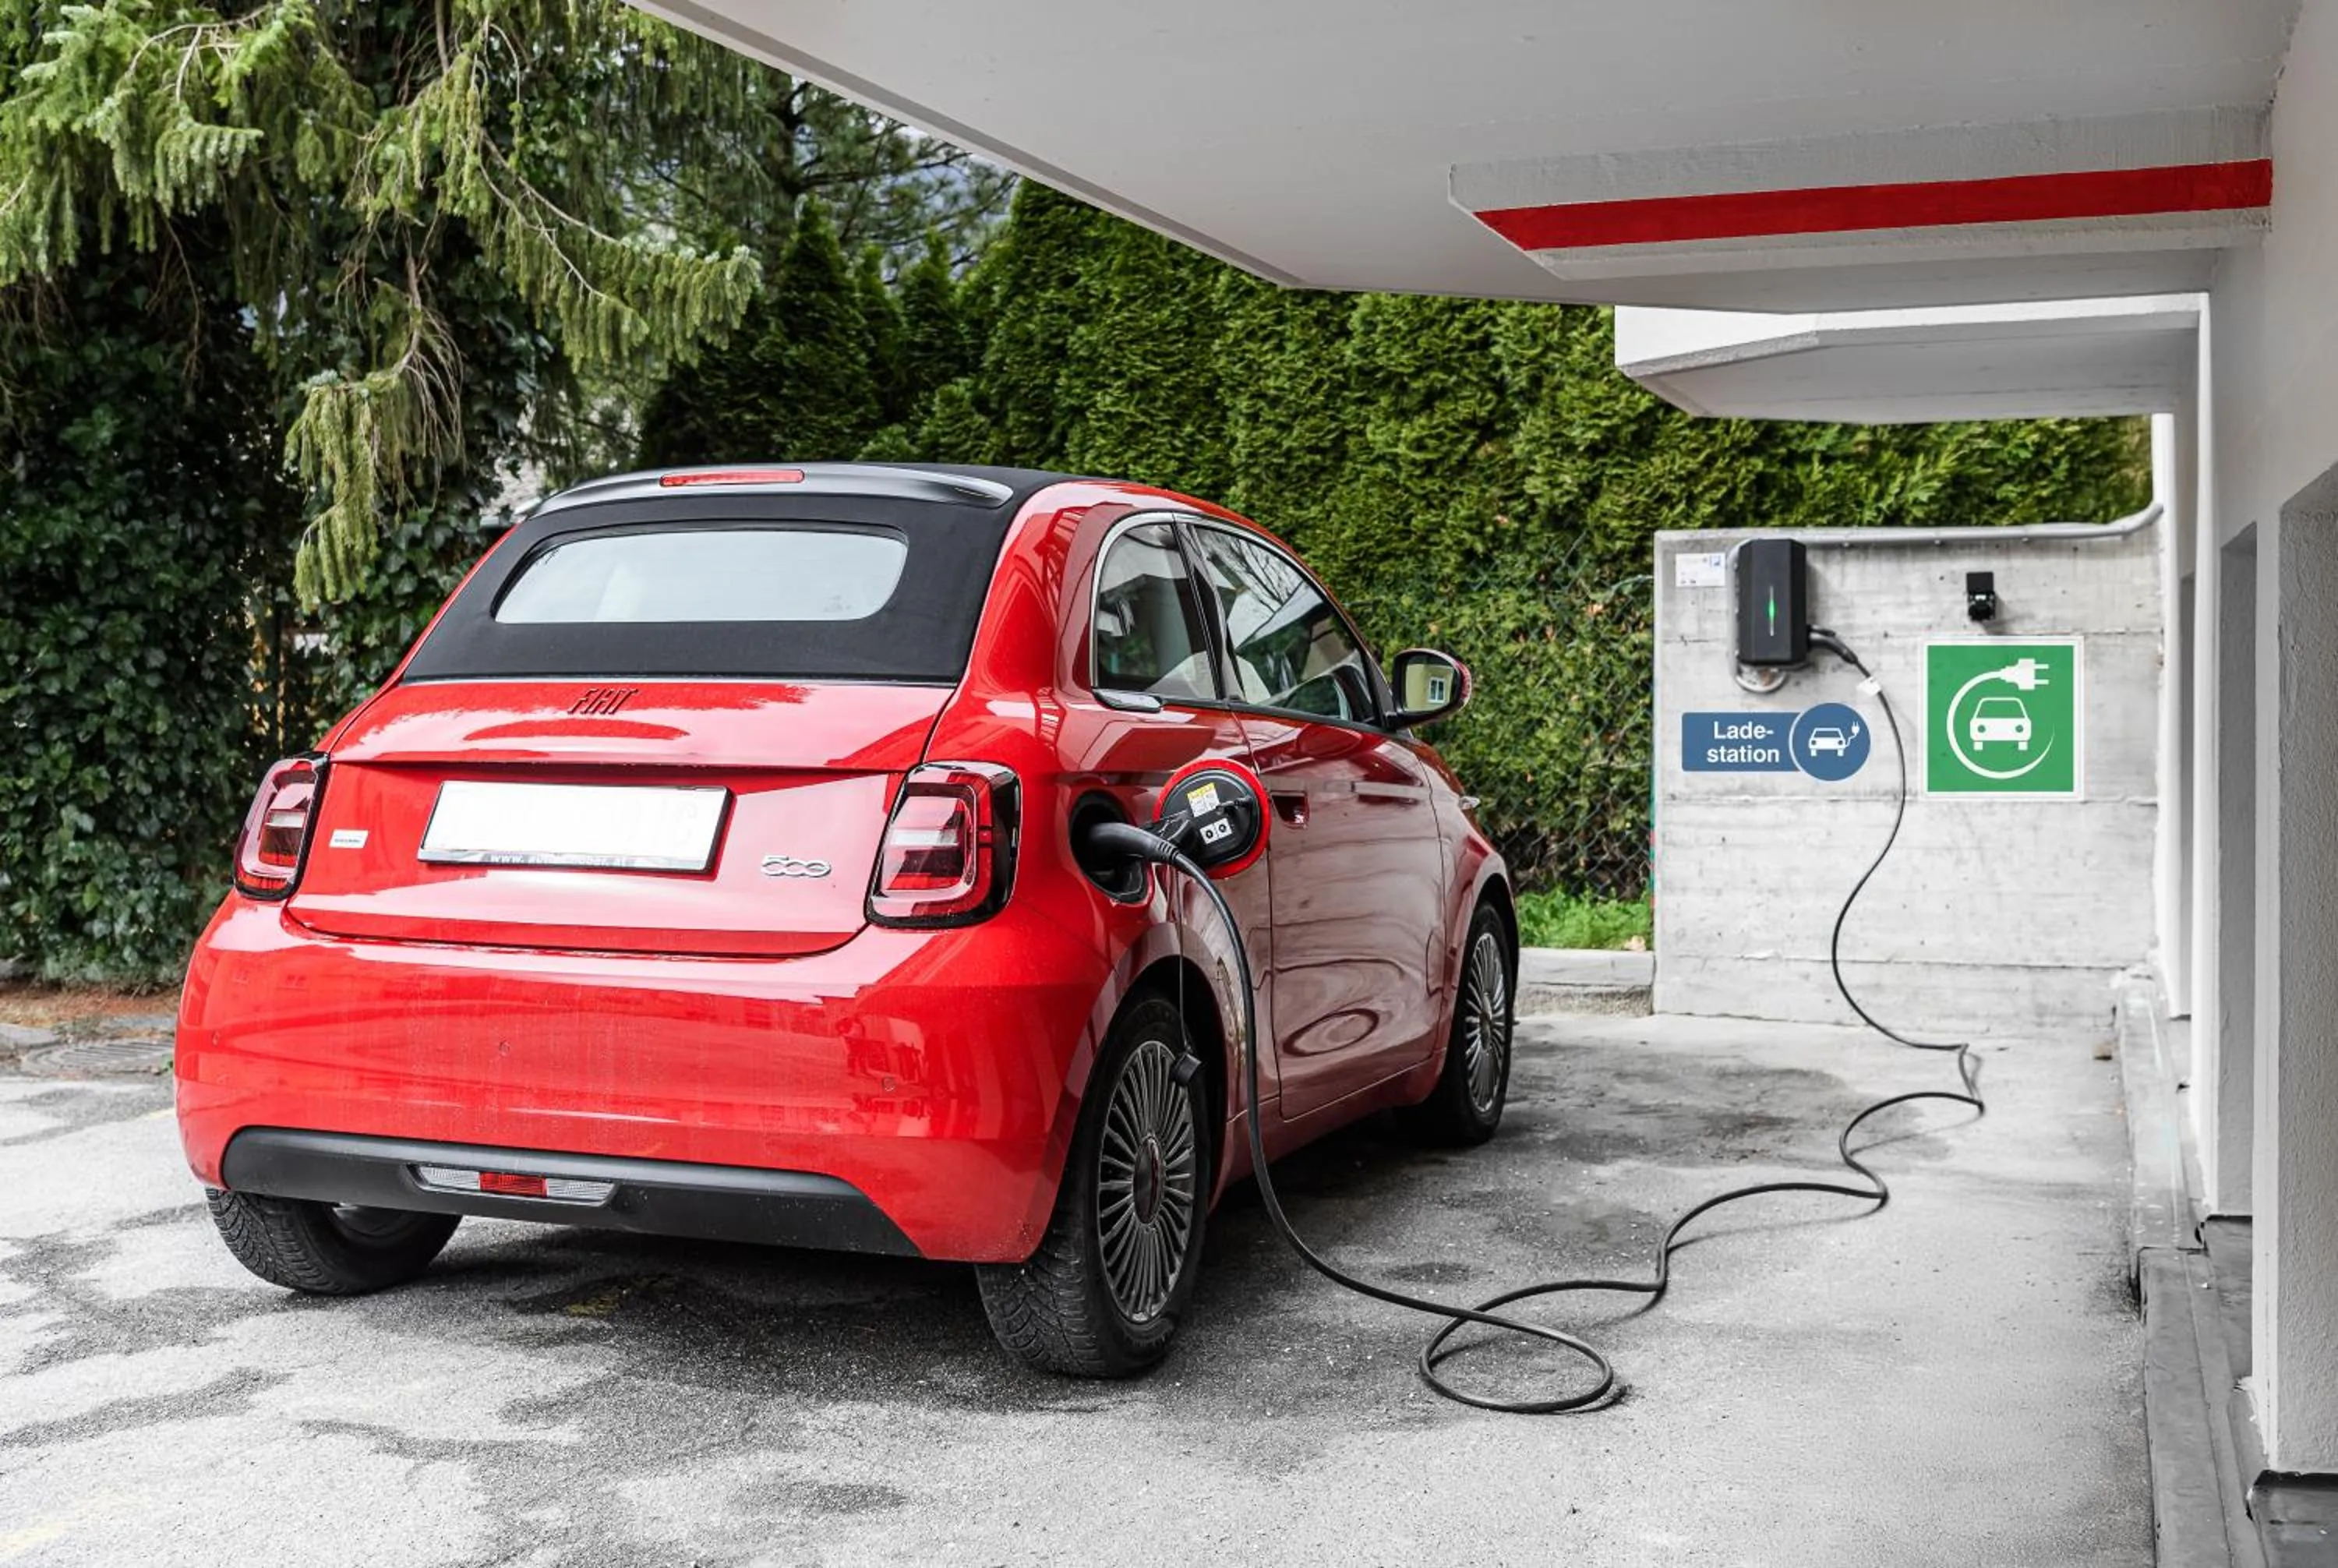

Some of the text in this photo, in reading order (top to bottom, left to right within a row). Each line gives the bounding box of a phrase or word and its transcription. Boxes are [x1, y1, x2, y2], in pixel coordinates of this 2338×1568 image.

[567, 688, 638, 715] FIAT
[1714, 721, 1774, 740] Lade-
[1707, 745, 1780, 763] station
